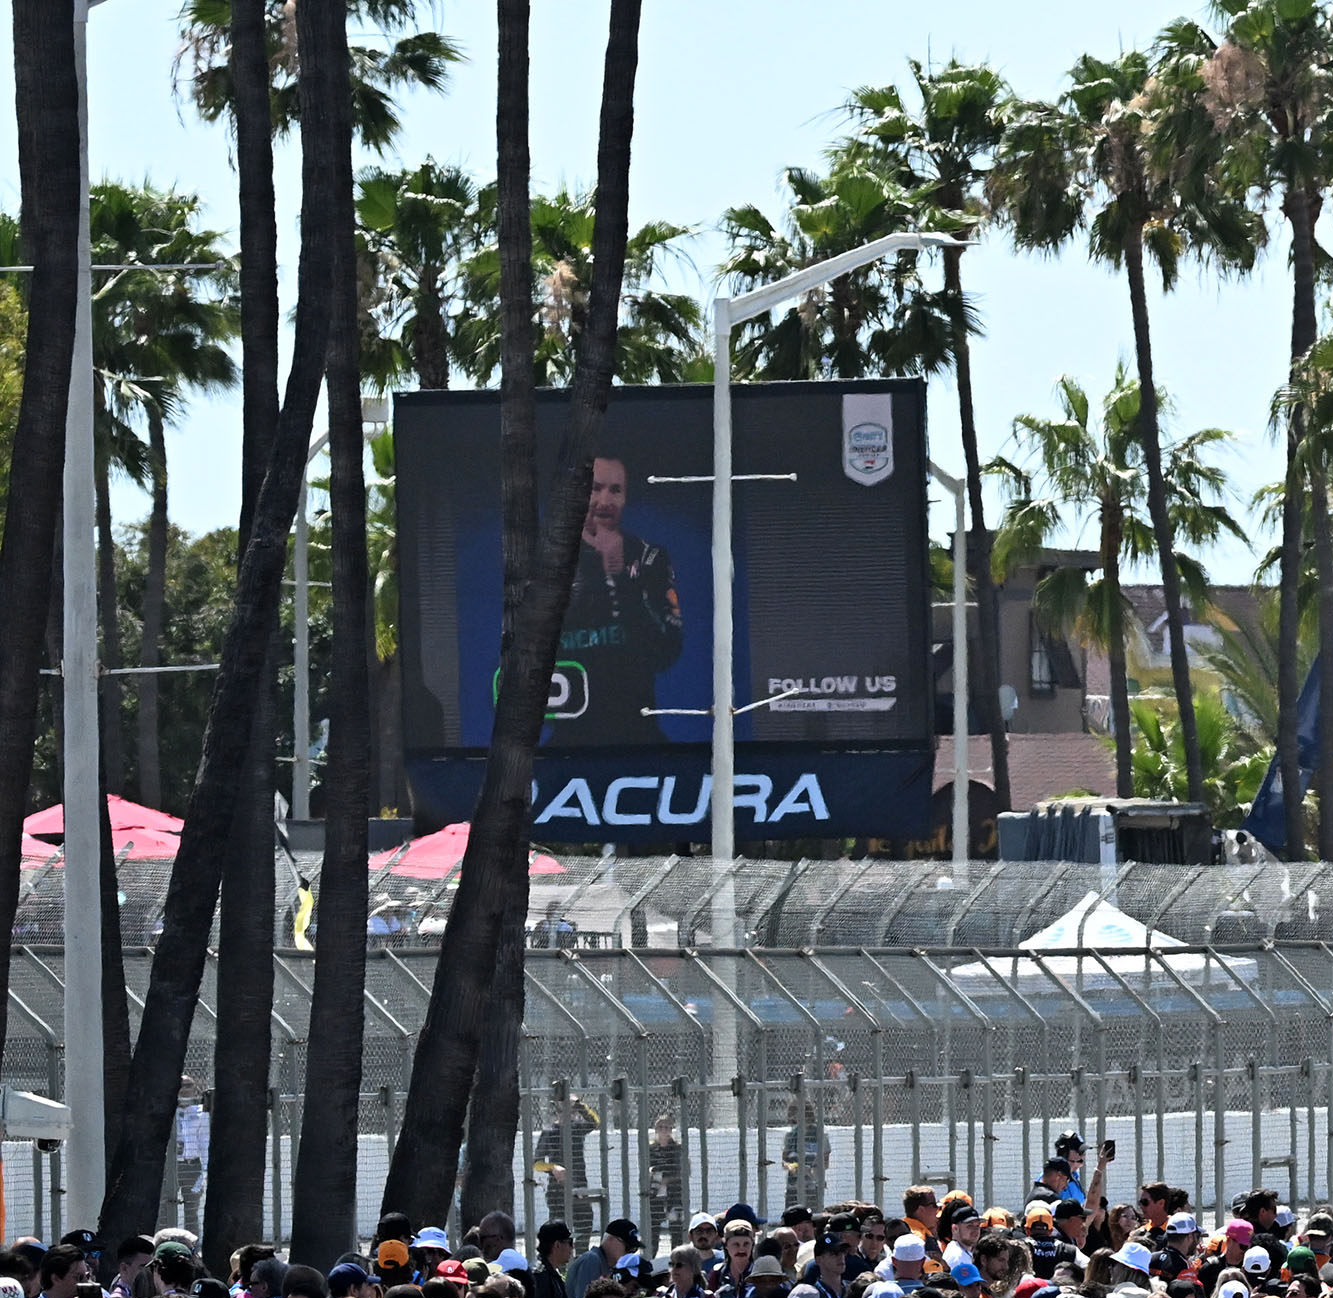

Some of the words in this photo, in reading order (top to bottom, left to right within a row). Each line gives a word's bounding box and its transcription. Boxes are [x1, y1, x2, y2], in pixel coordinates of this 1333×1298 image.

[768, 675, 858, 694] FOLLOW
[864, 675, 897, 693] US
[534, 773, 830, 825] ACURA
